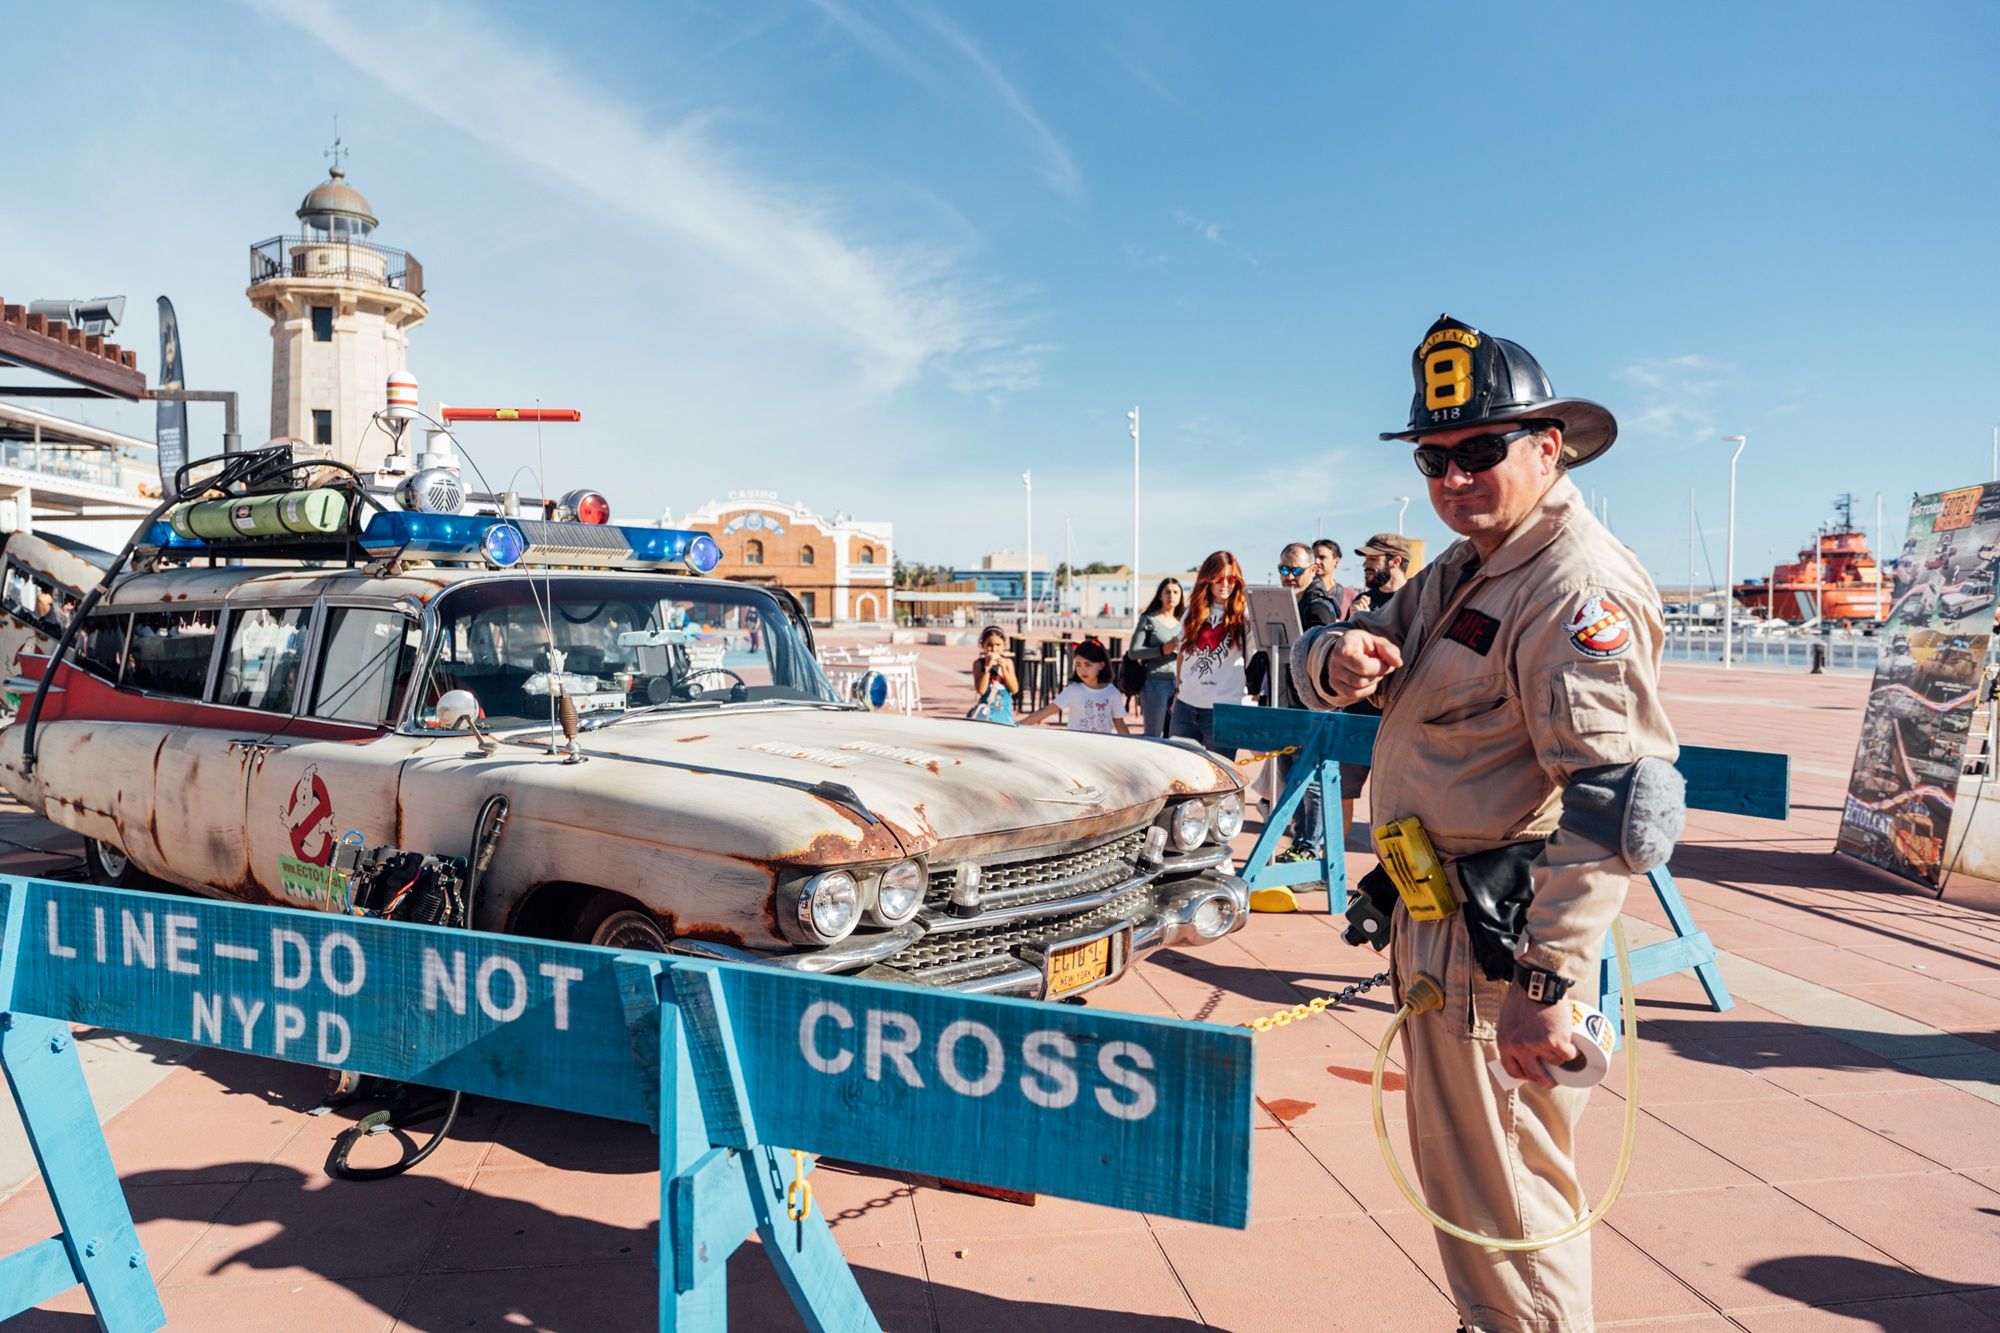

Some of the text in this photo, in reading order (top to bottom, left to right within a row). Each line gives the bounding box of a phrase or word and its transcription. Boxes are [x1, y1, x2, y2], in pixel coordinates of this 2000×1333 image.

[1421, 329, 1475, 356] CAPTAIN
[1424, 347, 1472, 412] 8
[1431, 407, 1461, 422] 418
[728, 489, 778, 500] CASINO
[192, 991, 352, 1064] NYPD
[423, 946, 583, 1031] NOT
[798, 1001, 1157, 1121] CROSS
